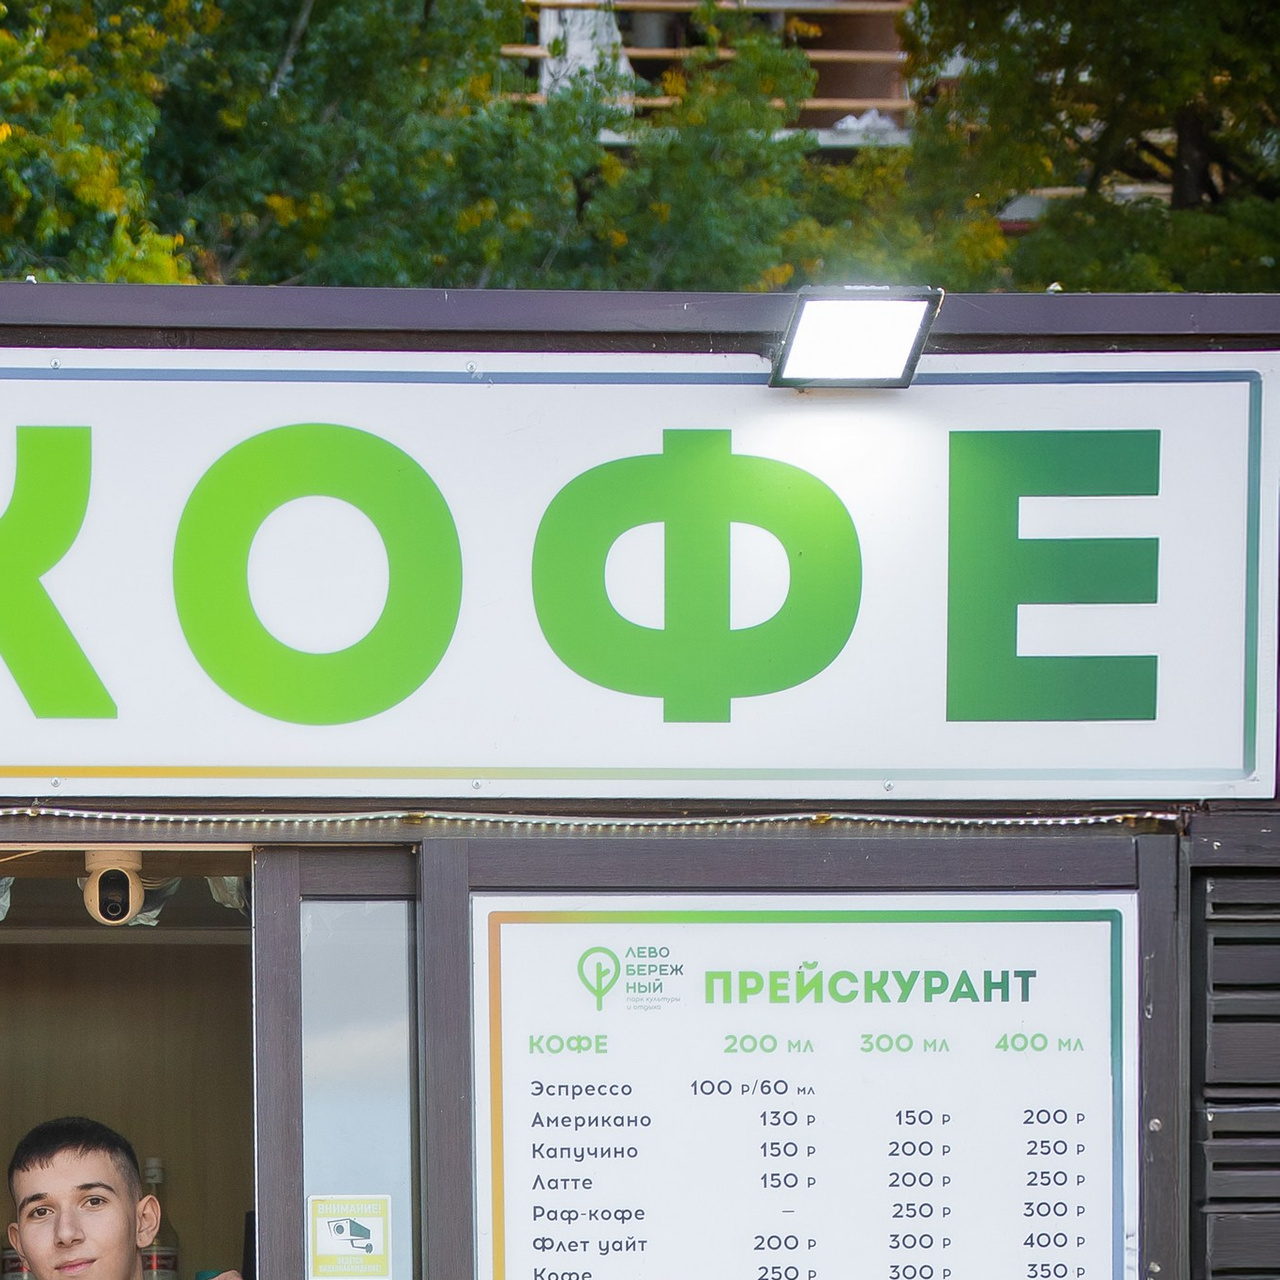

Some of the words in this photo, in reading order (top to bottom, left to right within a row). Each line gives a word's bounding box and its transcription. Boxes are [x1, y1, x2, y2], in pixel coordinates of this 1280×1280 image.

[625, 946, 670, 958] ЛЕВО
[626, 964, 684, 976] БЕРЕЖ
[626, 978, 663, 993] НЫЙ
[705, 961, 1037, 1004] ПРЕЙСКУРАНТ
[528, 1035, 608, 1055] КОФЕ
[724, 1034, 778, 1053] 200
[860, 1034, 914, 1053] 300
[995, 1033, 1049, 1052] 400
[531, 1081, 633, 1101] Эспрессо
[691, 1080, 733, 1096] 100
[531, 1112, 652, 1132] Американо
[760, 1111, 798, 1127] 130
[896, 1110, 934, 1126] 150
[1023, 1109, 1068, 1125] 200
[532, 1143, 638, 1163] Капучино
[761, 1142, 799, 1158] 150
[889, 1141, 934, 1157] 200
[1027, 1140, 1068, 1156] 250
[532, 1175, 593, 1191] Латте
[761, 1173, 799, 1189] 150
[889, 1172, 934, 1188] 200
[1027, 1171, 1068, 1187] 250
[317, 1203, 382, 1214] ВНИМАНИЕ!
[532, 1205, 646, 1225] Раф-кофе
[892, 1203, 934, 1219] 250
[1023, 1202, 1068, 1218] 300
[532, 1236, 590, 1253] Флет
[598, 1236, 648, 1256] уайт
[754, 1235, 799, 1251] 200
[889, 1234, 934, 1250] 300
[1023, 1233, 1068, 1249] 400
[889, 1265, 934, 1280] 300
[1027, 1264, 1068, 1279] 350
